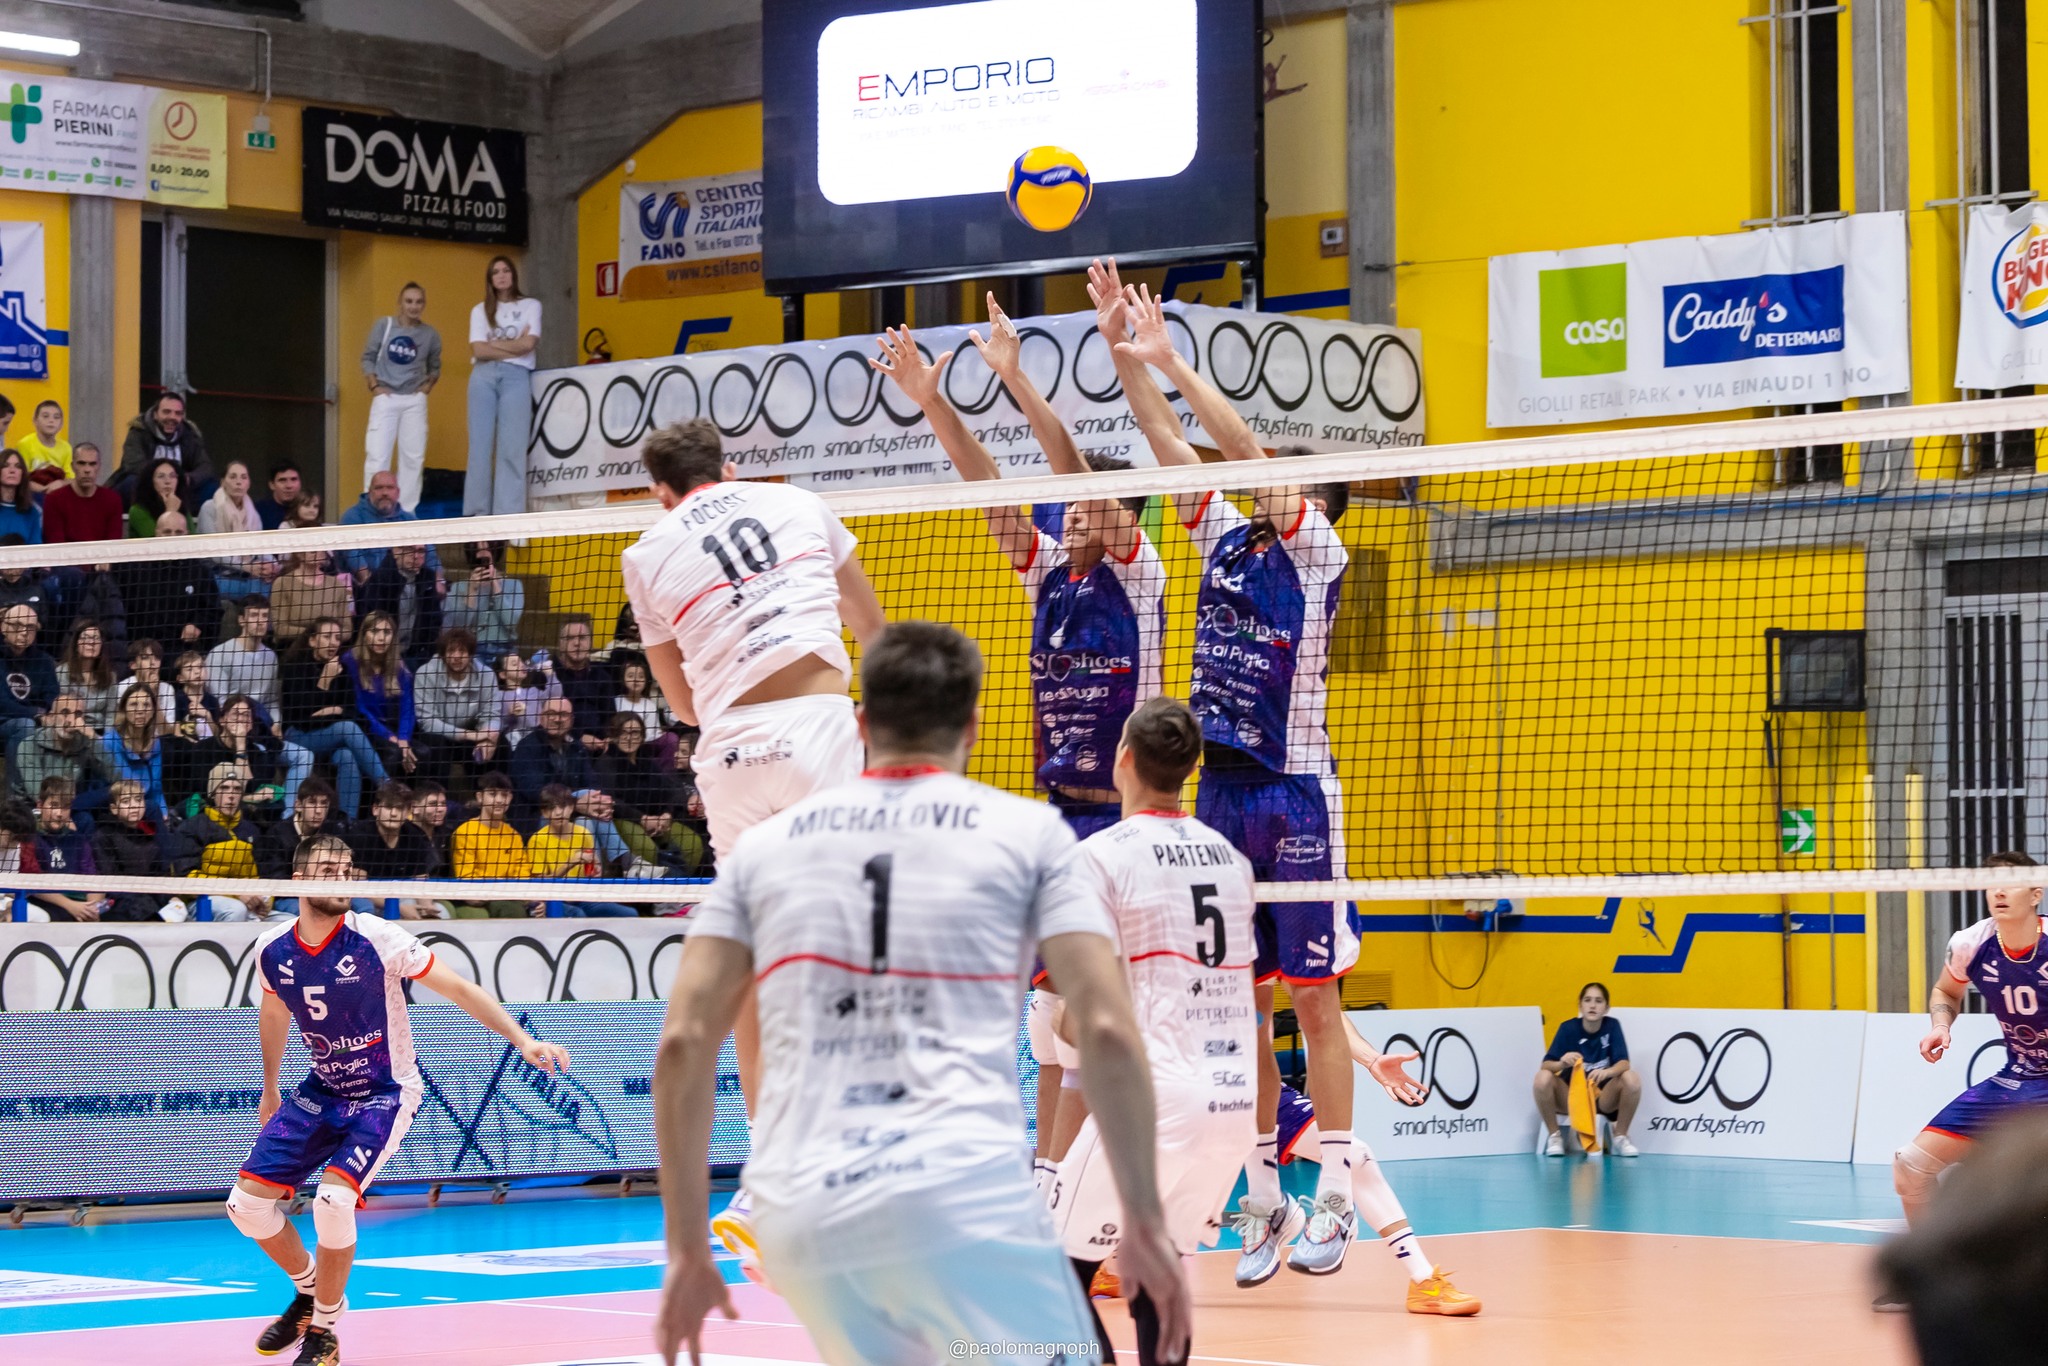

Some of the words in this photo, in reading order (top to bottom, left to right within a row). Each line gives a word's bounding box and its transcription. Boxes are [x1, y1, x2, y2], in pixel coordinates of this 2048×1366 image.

[858, 56, 1055, 101] EMPORIO
[53, 99, 138, 120] FARMACIA
[853, 102, 925, 120] RICAMBI
[931, 97, 982, 113] AUTO
[988, 95, 999, 107] E
[1005, 89, 1061, 105] MOTO
[54, 118, 114, 138] PIERINI
[325, 123, 506, 199] DOMA
[695, 181, 764, 204] CENTRO
[694, 214, 764, 235] ITALIAN
[700, 199, 762, 220] SPORTI
[641, 241, 686, 261] FANO
[2003, 238, 2048, 283] BUGE
[667, 259, 761, 281] www.csifano
[1564, 316, 1626, 346] casa
[1668, 290, 1788, 344] Caddy's
[1518, 394, 1574, 414] GIOLLI
[1580, 389, 1624, 411] RETAIL
[1629, 385, 1671, 405] PARK
[1693, 382, 1725, 399] VIA
[1732, 374, 1813, 396] EINAUDI
[823, 431, 936, 458] smartsystem
[1321, 423, 1425, 449] smartsystem
[702, 517, 778, 590] 10
[863, 853, 893, 975] 1
[1191, 883, 1227, 968] 5
[302, 986, 328, 1020] 5
[2001, 985, 2039, 1016] 10
[332, 1029, 383, 1051] shoes
[161, 1090, 262, 1115] APPLICATI
[1393, 1113, 1489, 1139] smartsystem
[1647, 1113, 1766, 1139] smartsystem
